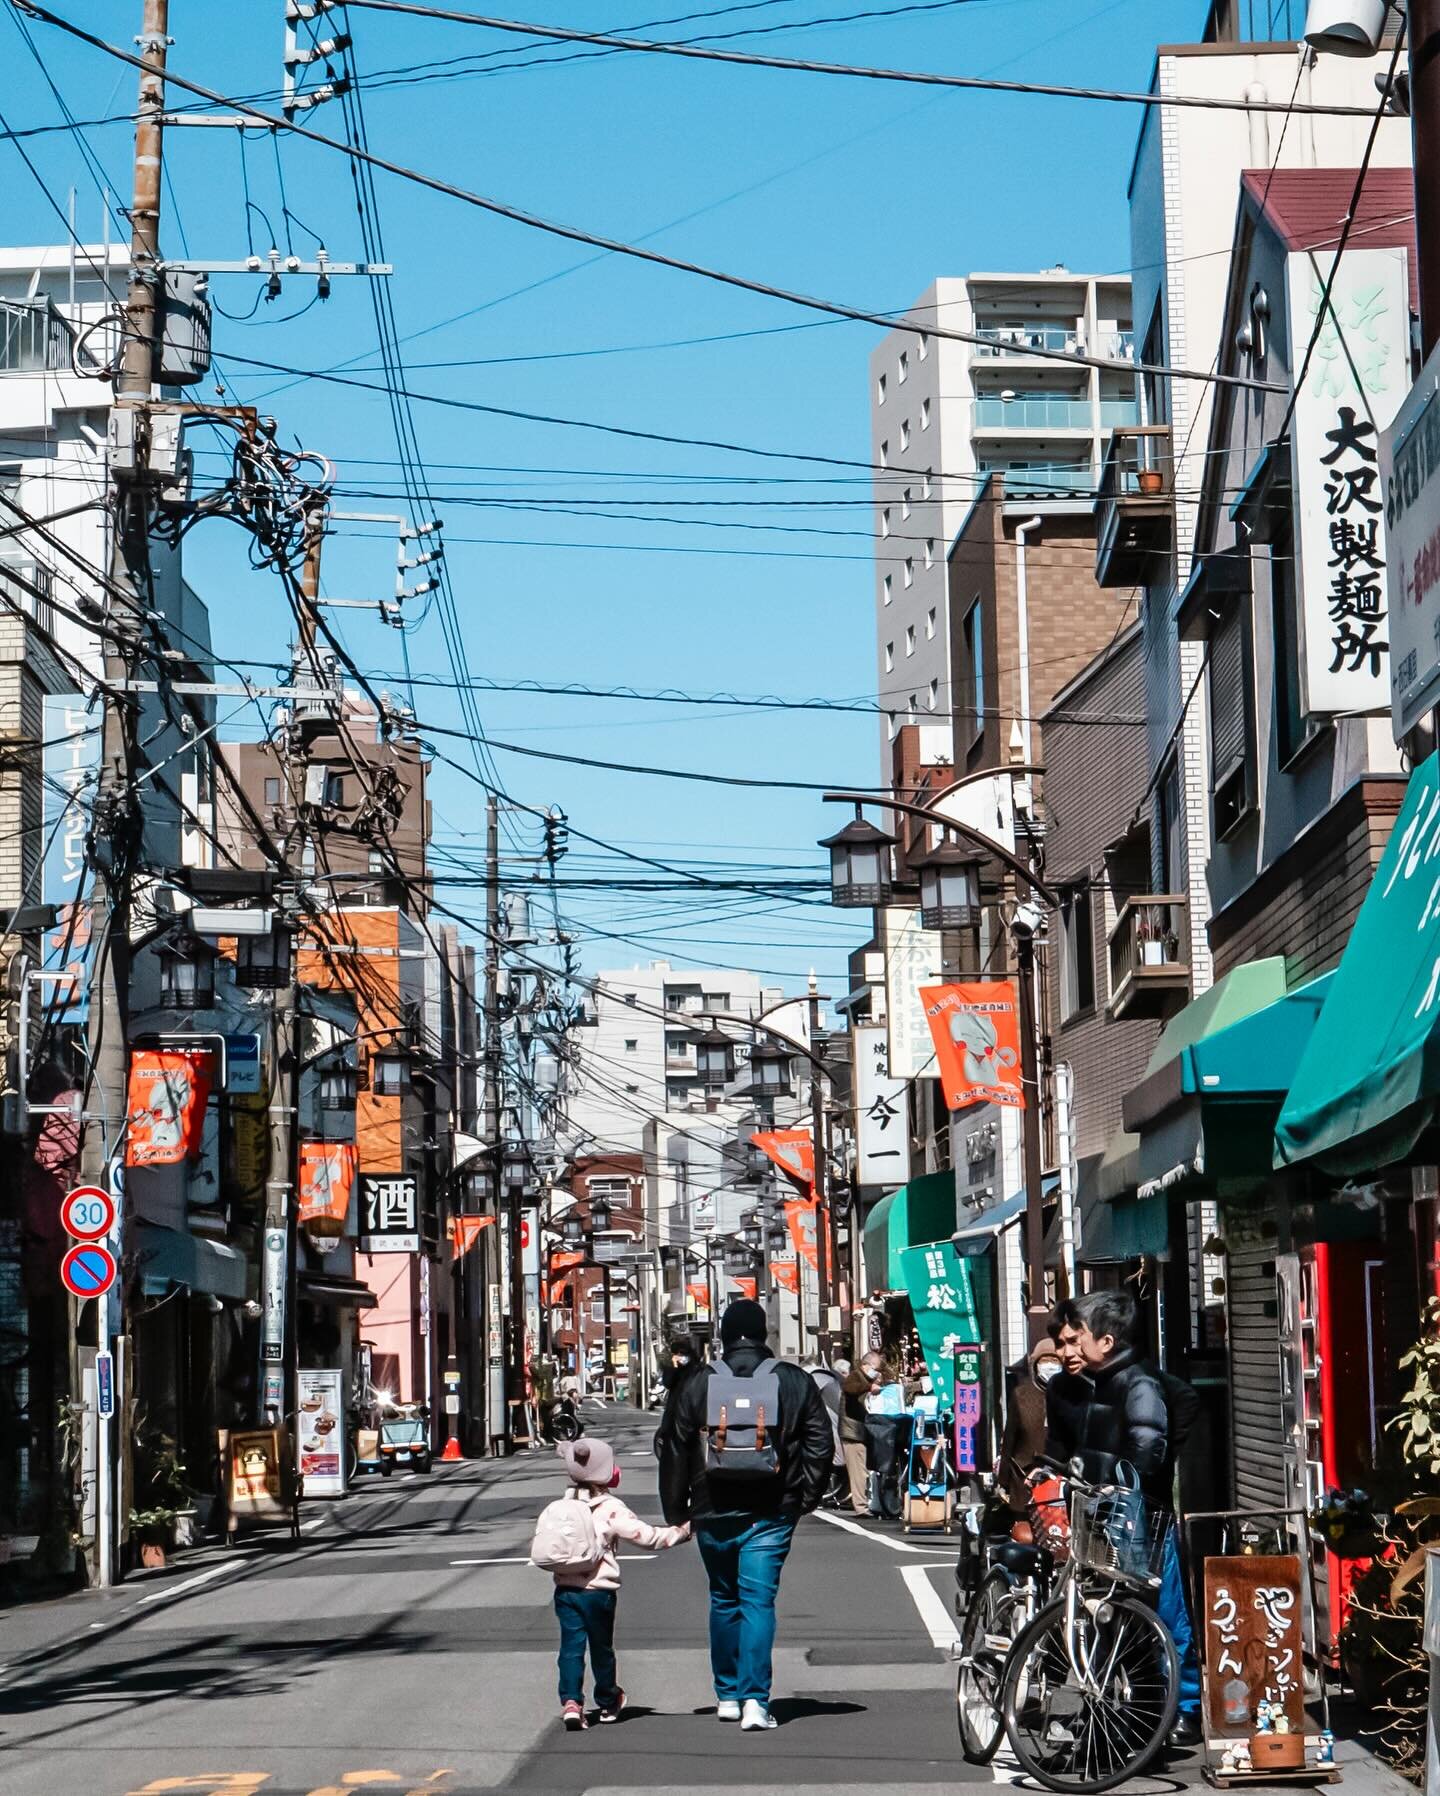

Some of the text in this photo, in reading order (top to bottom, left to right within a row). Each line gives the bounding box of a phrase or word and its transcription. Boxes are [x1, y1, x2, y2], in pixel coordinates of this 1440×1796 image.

[1320, 406, 1390, 678] 大沢製麺所
[865, 1094, 901, 1159] 今一
[74, 1202, 103, 1226] 30
[364, 1177, 416, 1230] 酒
[1210, 1588, 1244, 1675] うどん
